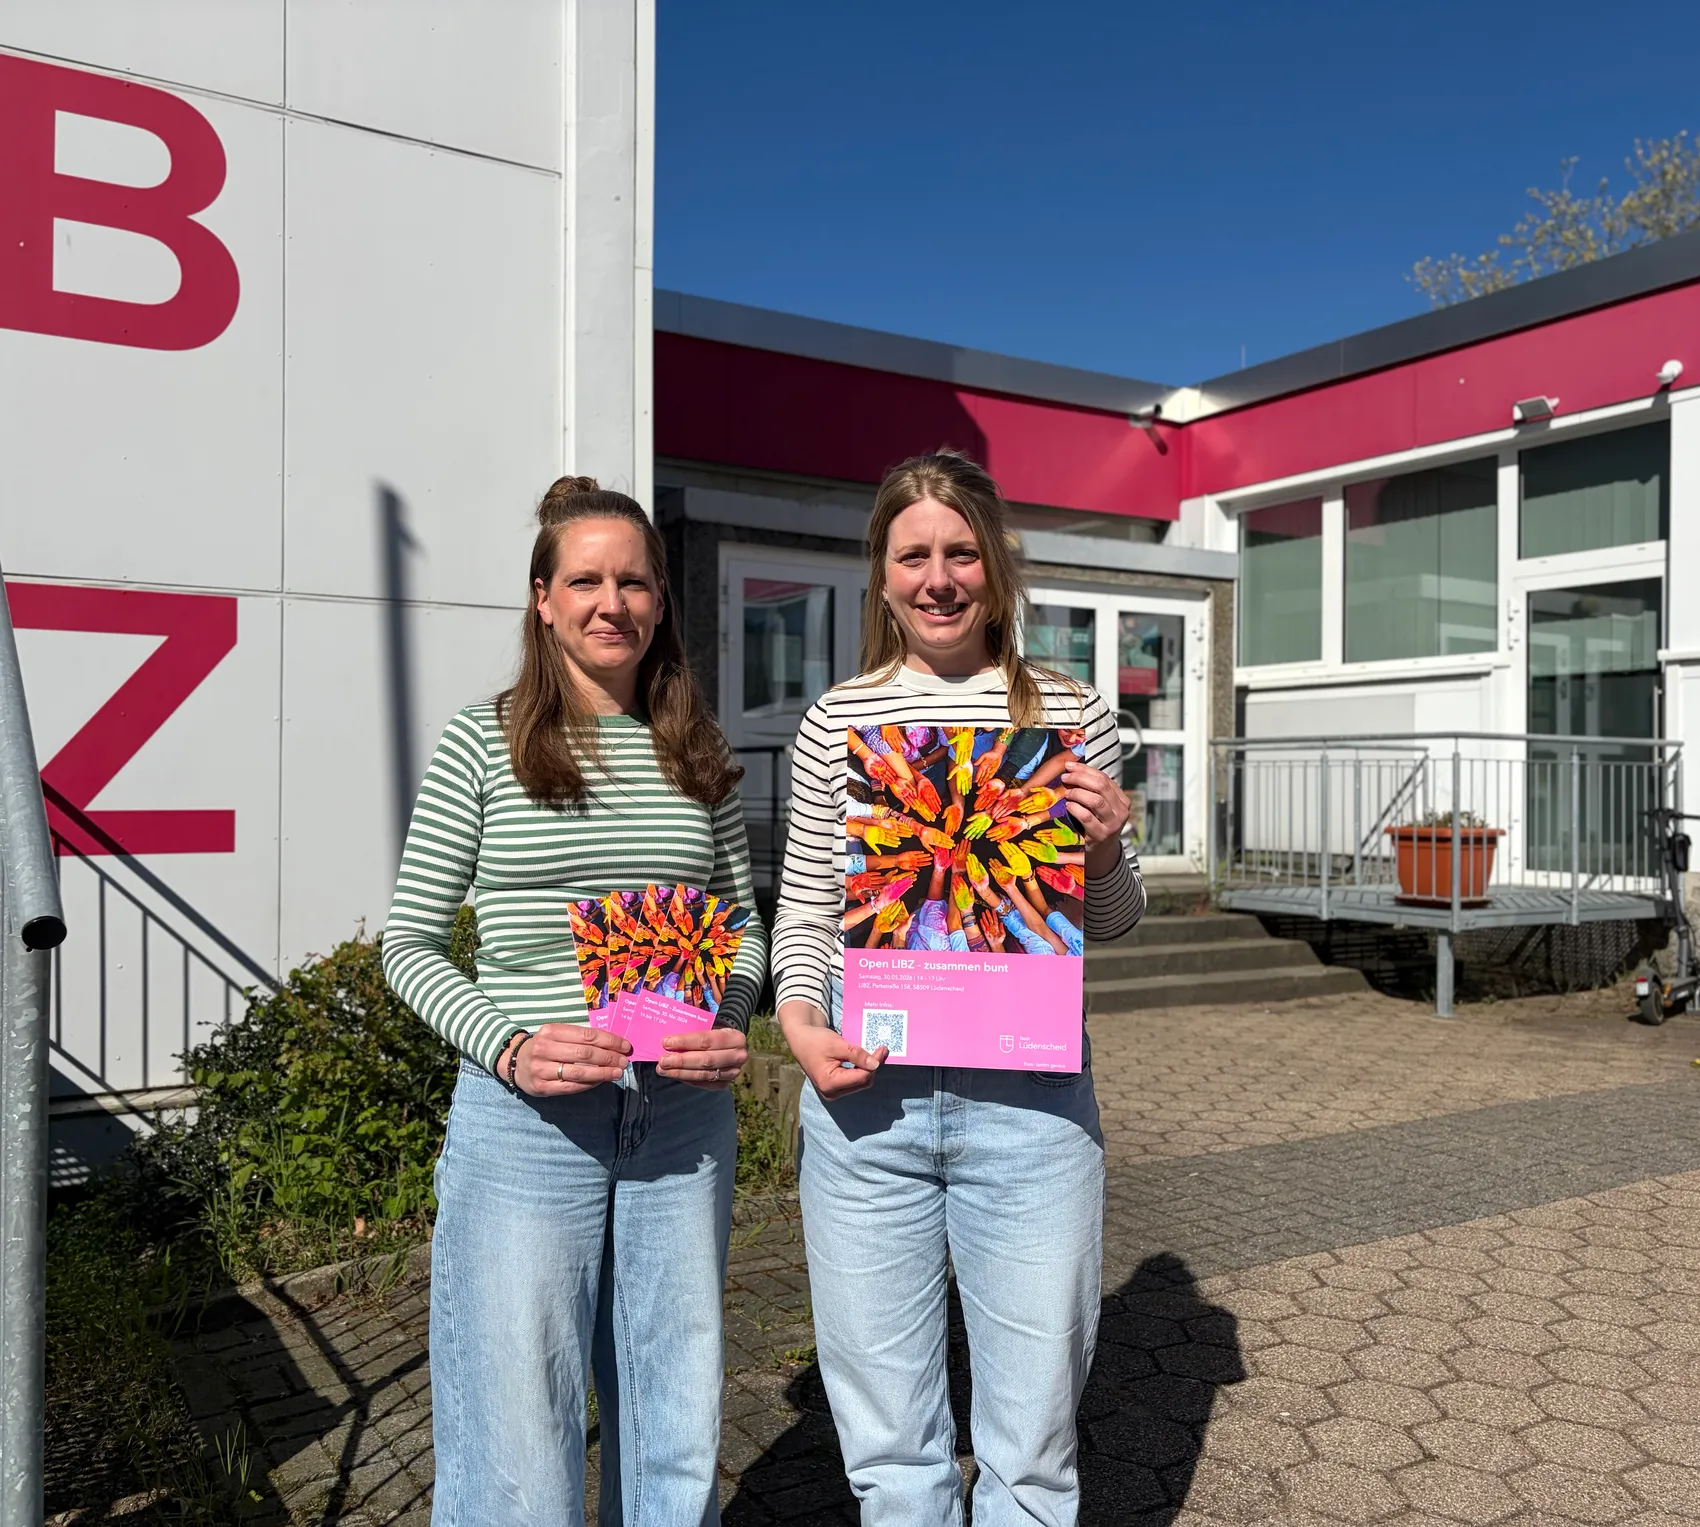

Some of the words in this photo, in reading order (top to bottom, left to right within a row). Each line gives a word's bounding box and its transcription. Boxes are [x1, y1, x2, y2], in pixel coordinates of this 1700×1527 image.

[0, 54, 240, 351] B
[5, 582, 238, 857] Z
[859, 958, 888, 970] Open
[891, 959, 915, 969] LIBZ
[924, 962, 981, 971] zusammen
[983, 961, 1009, 973] bunt
[930, 984, 965, 992] Lüdenscheid
[644, 996, 658, 1006] Open
[1018, 1041, 1067, 1051] Lüdenscheid
